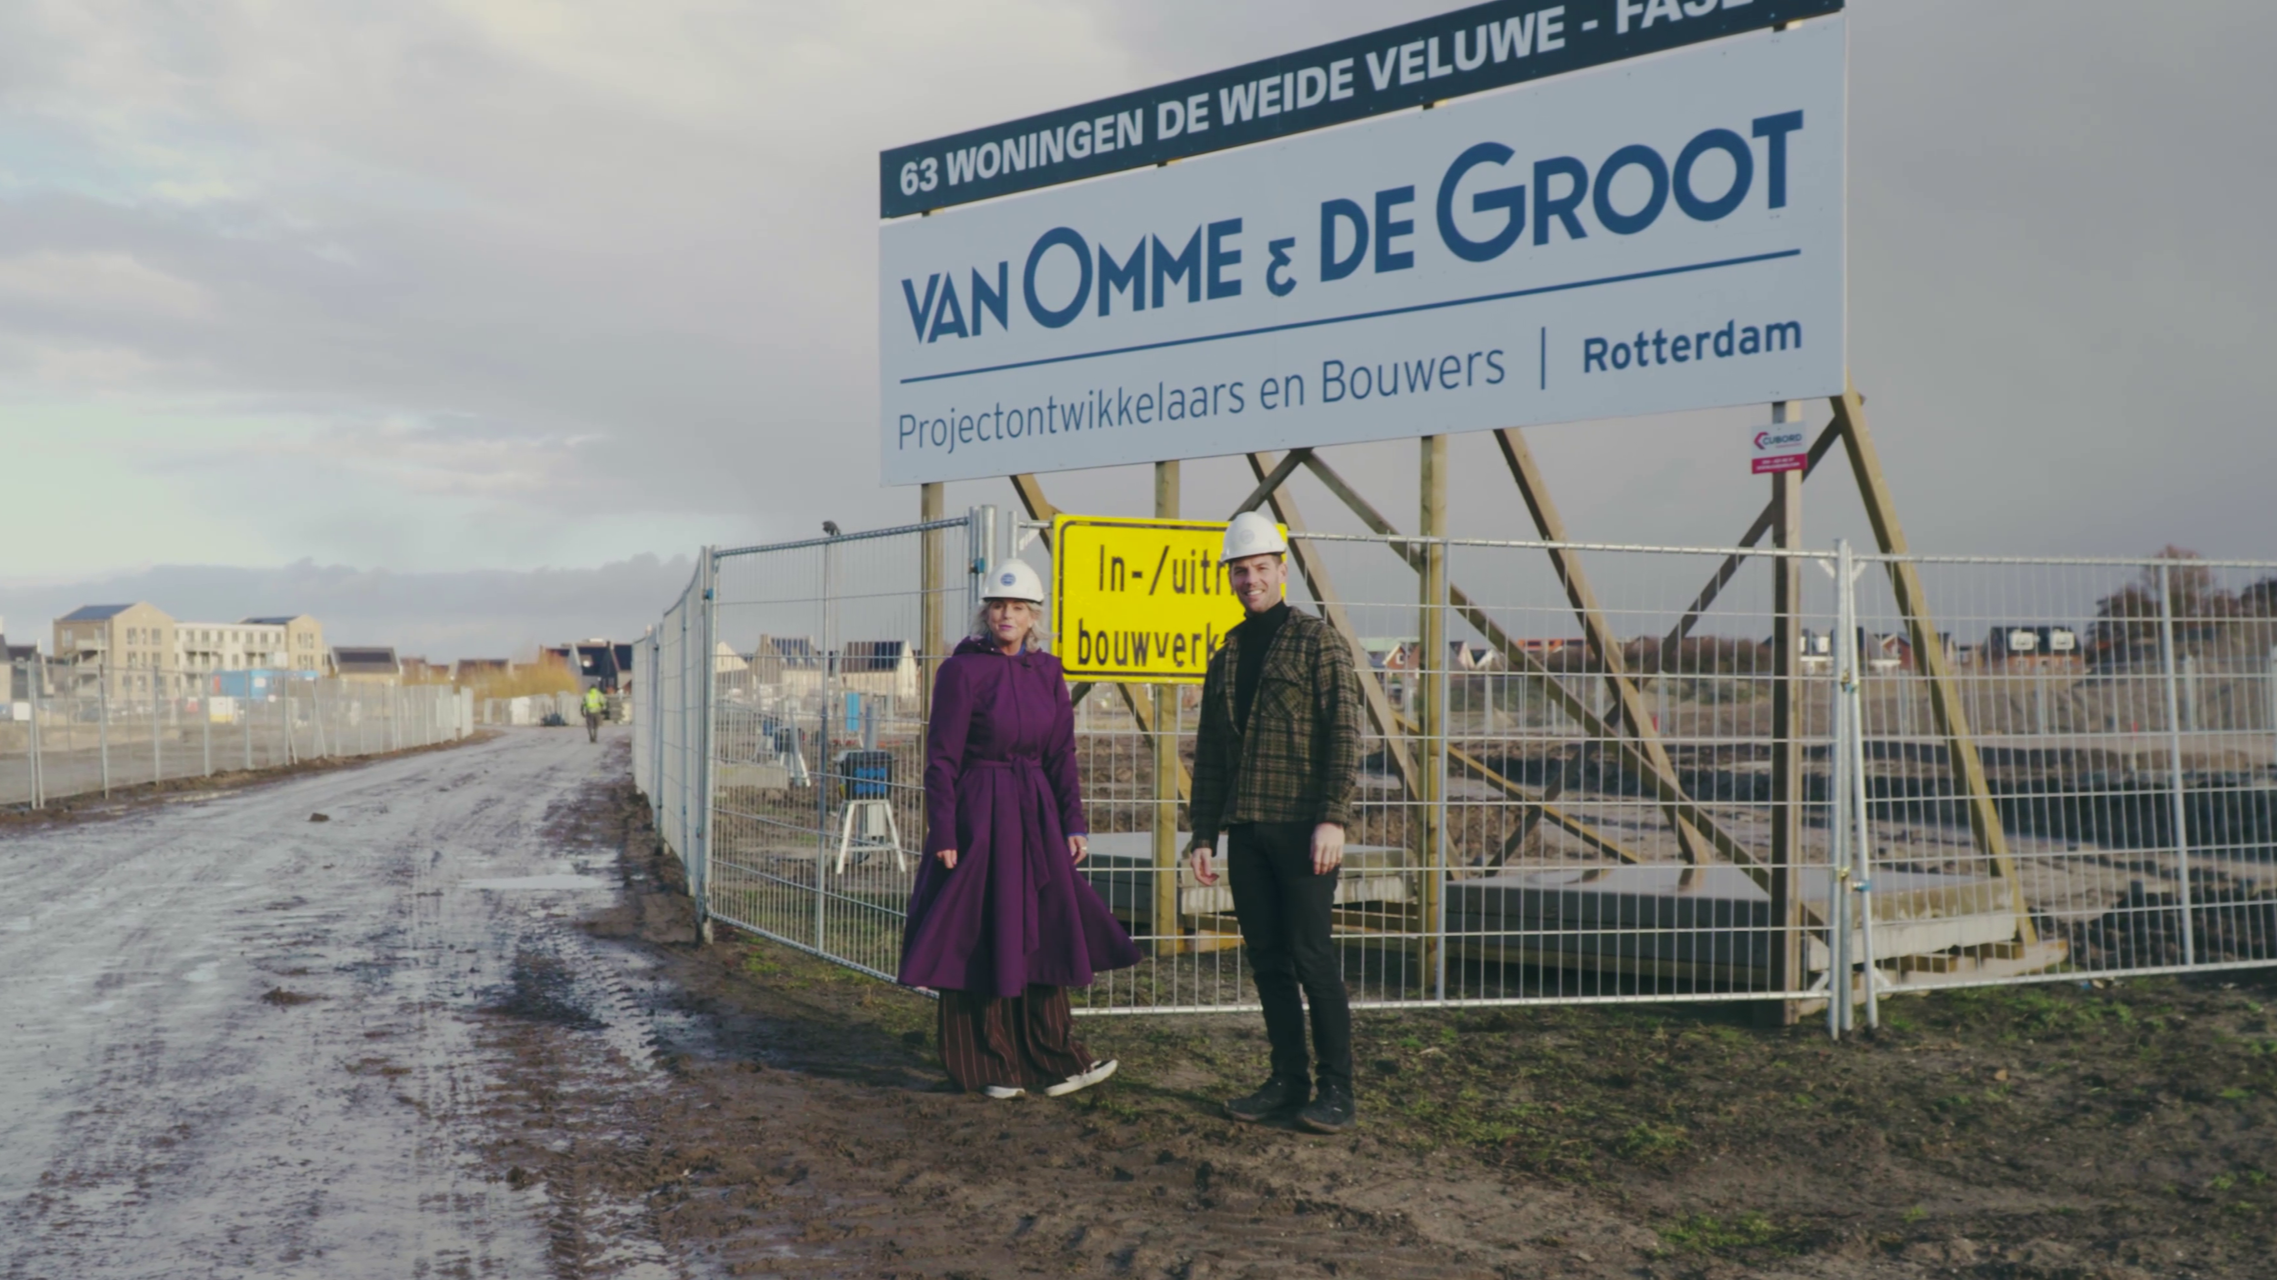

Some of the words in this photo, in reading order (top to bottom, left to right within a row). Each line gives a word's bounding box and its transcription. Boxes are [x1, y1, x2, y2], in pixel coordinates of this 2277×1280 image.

[900, 157, 938, 196] 63
[946, 108, 1143, 186] WONINGEN
[1157, 92, 1210, 140] DE
[1219, 57, 1355, 126] WEIDE
[1366, 5, 1566, 91] VELUWE
[1617, 0, 1754, 34] FA
[901, 260, 1009, 344] VAN
[1022, 217, 1243, 329] OMME
[1319, 184, 1416, 283] DE
[1435, 109, 1805, 263] GROOT
[898, 380, 1246, 455] Projectontwikkelaars
[1260, 374, 1305, 411] en
[1322, 349, 1506, 404] Bouwers
[1583, 319, 1803, 374] Rotterdam
[1077, 617, 1220, 668] bouwverk
